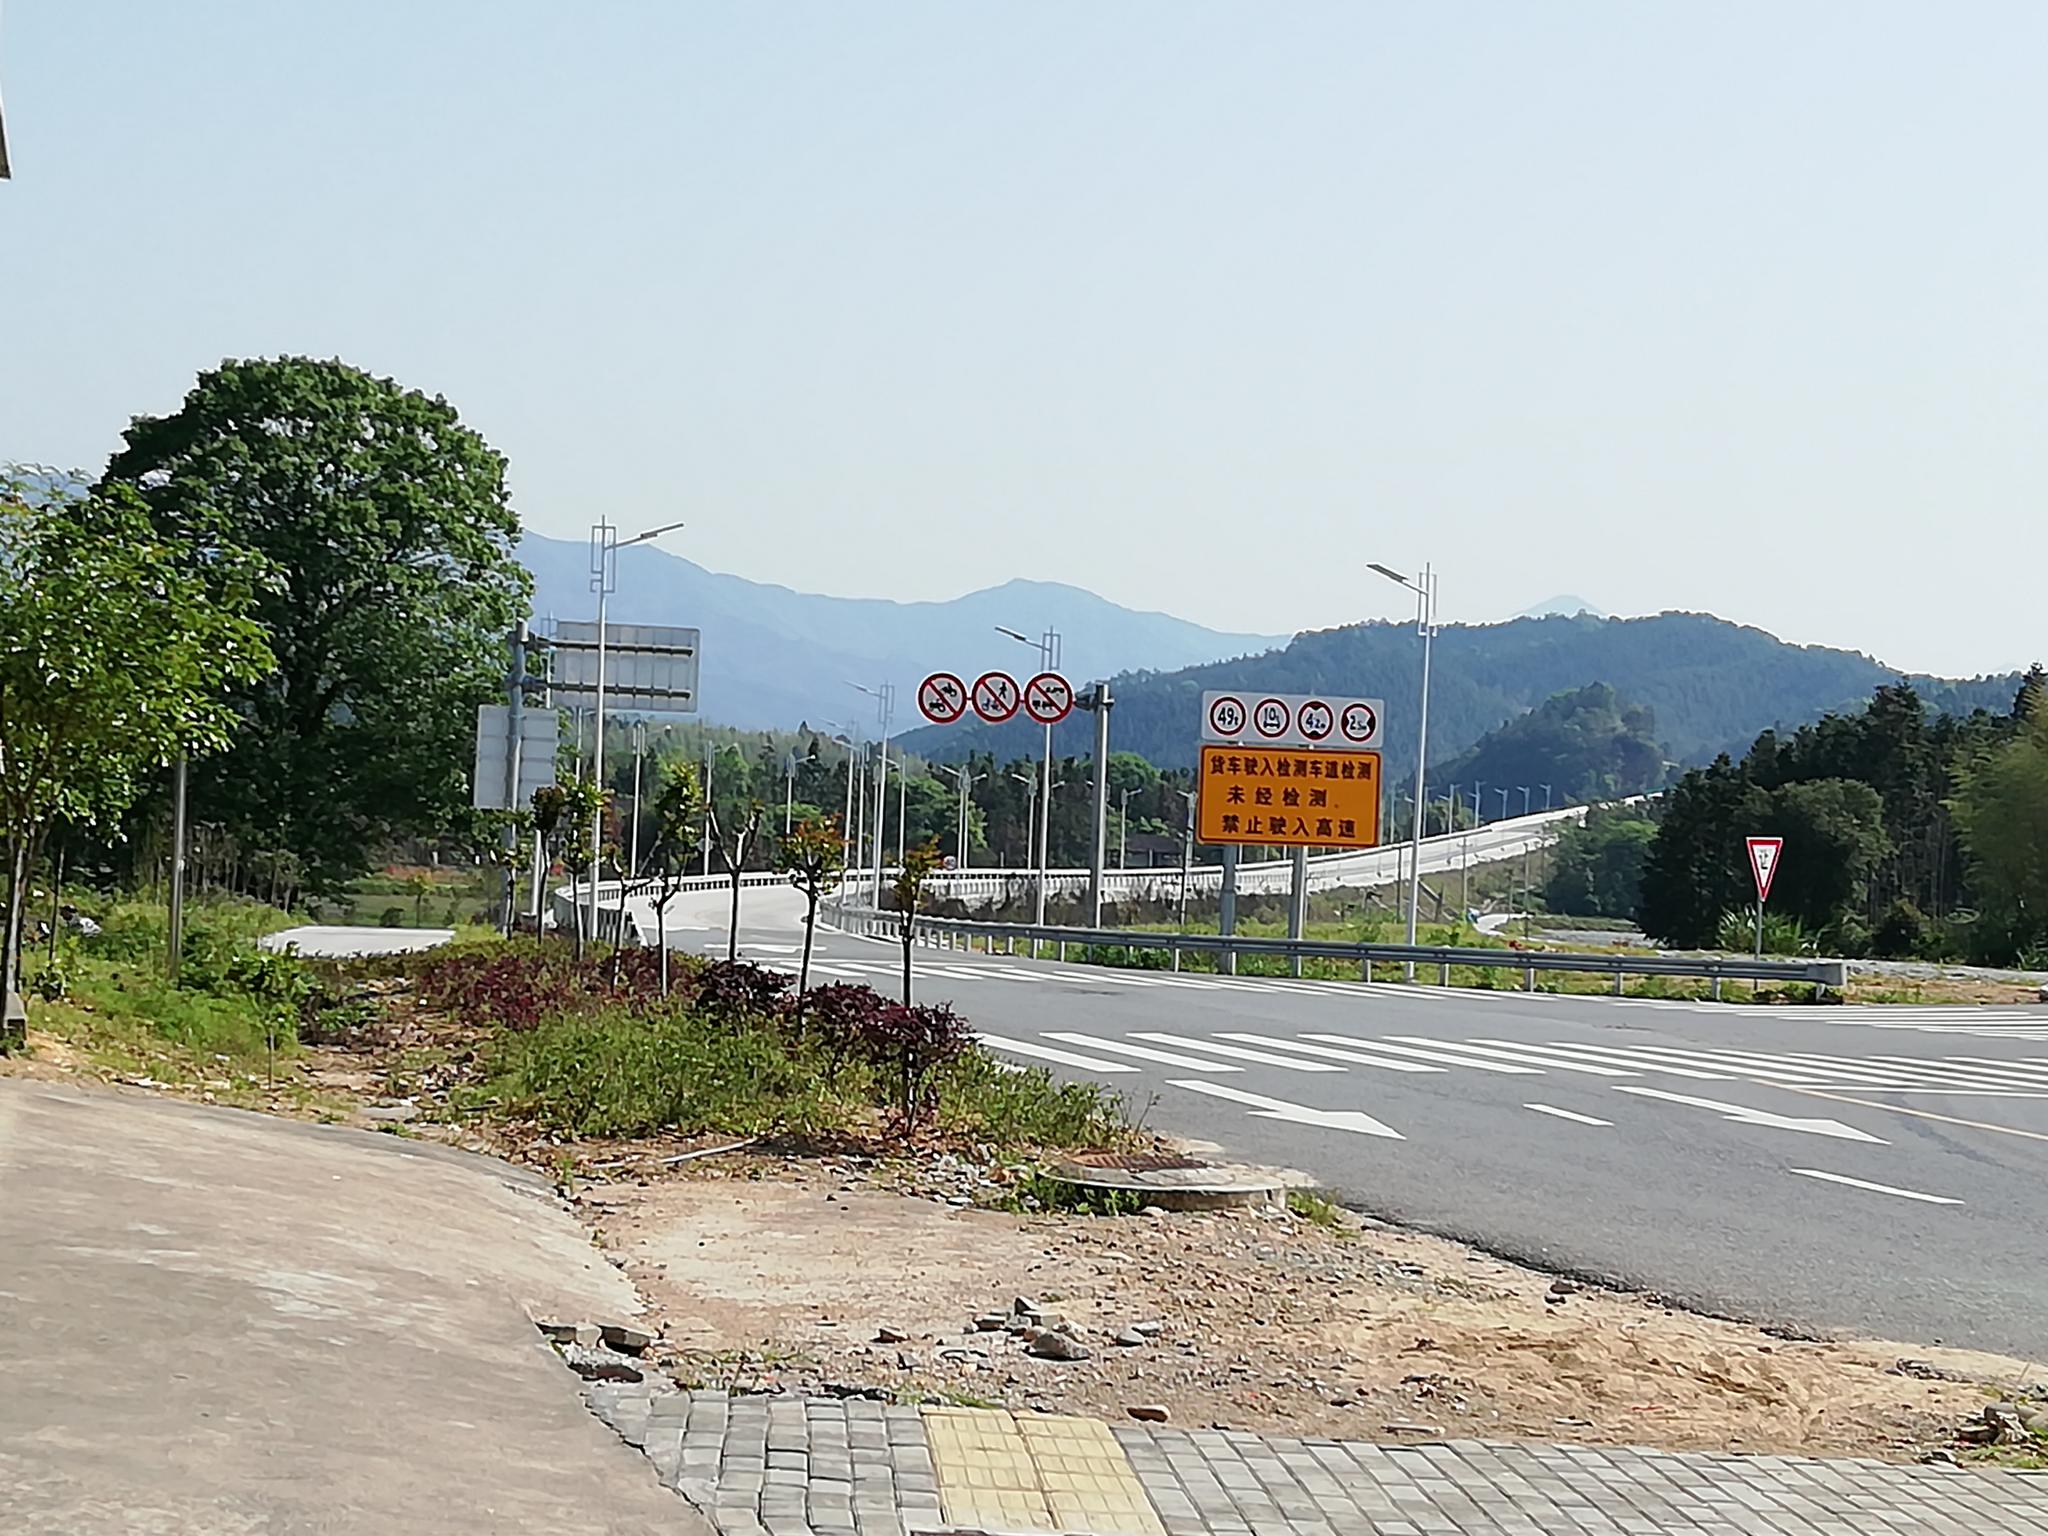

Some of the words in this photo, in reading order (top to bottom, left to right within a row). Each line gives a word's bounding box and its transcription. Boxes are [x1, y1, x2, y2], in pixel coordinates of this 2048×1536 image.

[1210, 755, 1372, 780] 货车驶入检测车道检测
[1222, 814, 1357, 839] 禁止驶入高速
